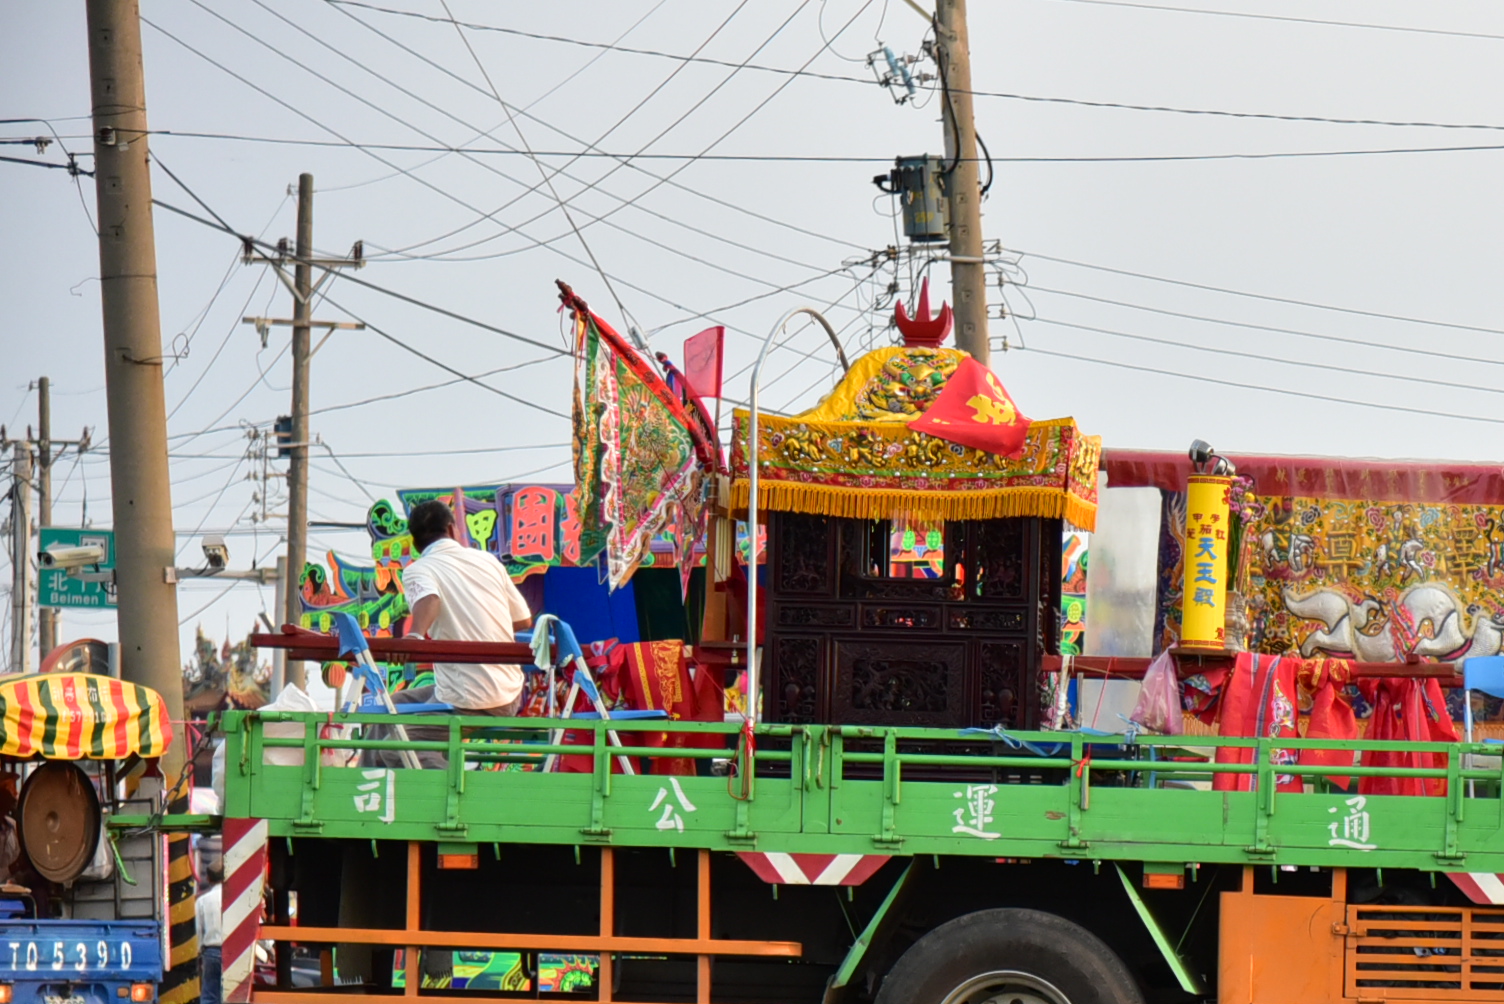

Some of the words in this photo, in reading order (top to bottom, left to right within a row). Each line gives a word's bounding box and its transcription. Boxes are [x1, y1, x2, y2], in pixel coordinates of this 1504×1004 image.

[50, 593, 98, 604] Beimen
[1194, 537, 1217, 607] 天王殿
[353, 768, 395, 824] 司
[648, 777, 697, 833] 公
[952, 785, 1001, 840] 運
[1328, 796, 1377, 852] 通
